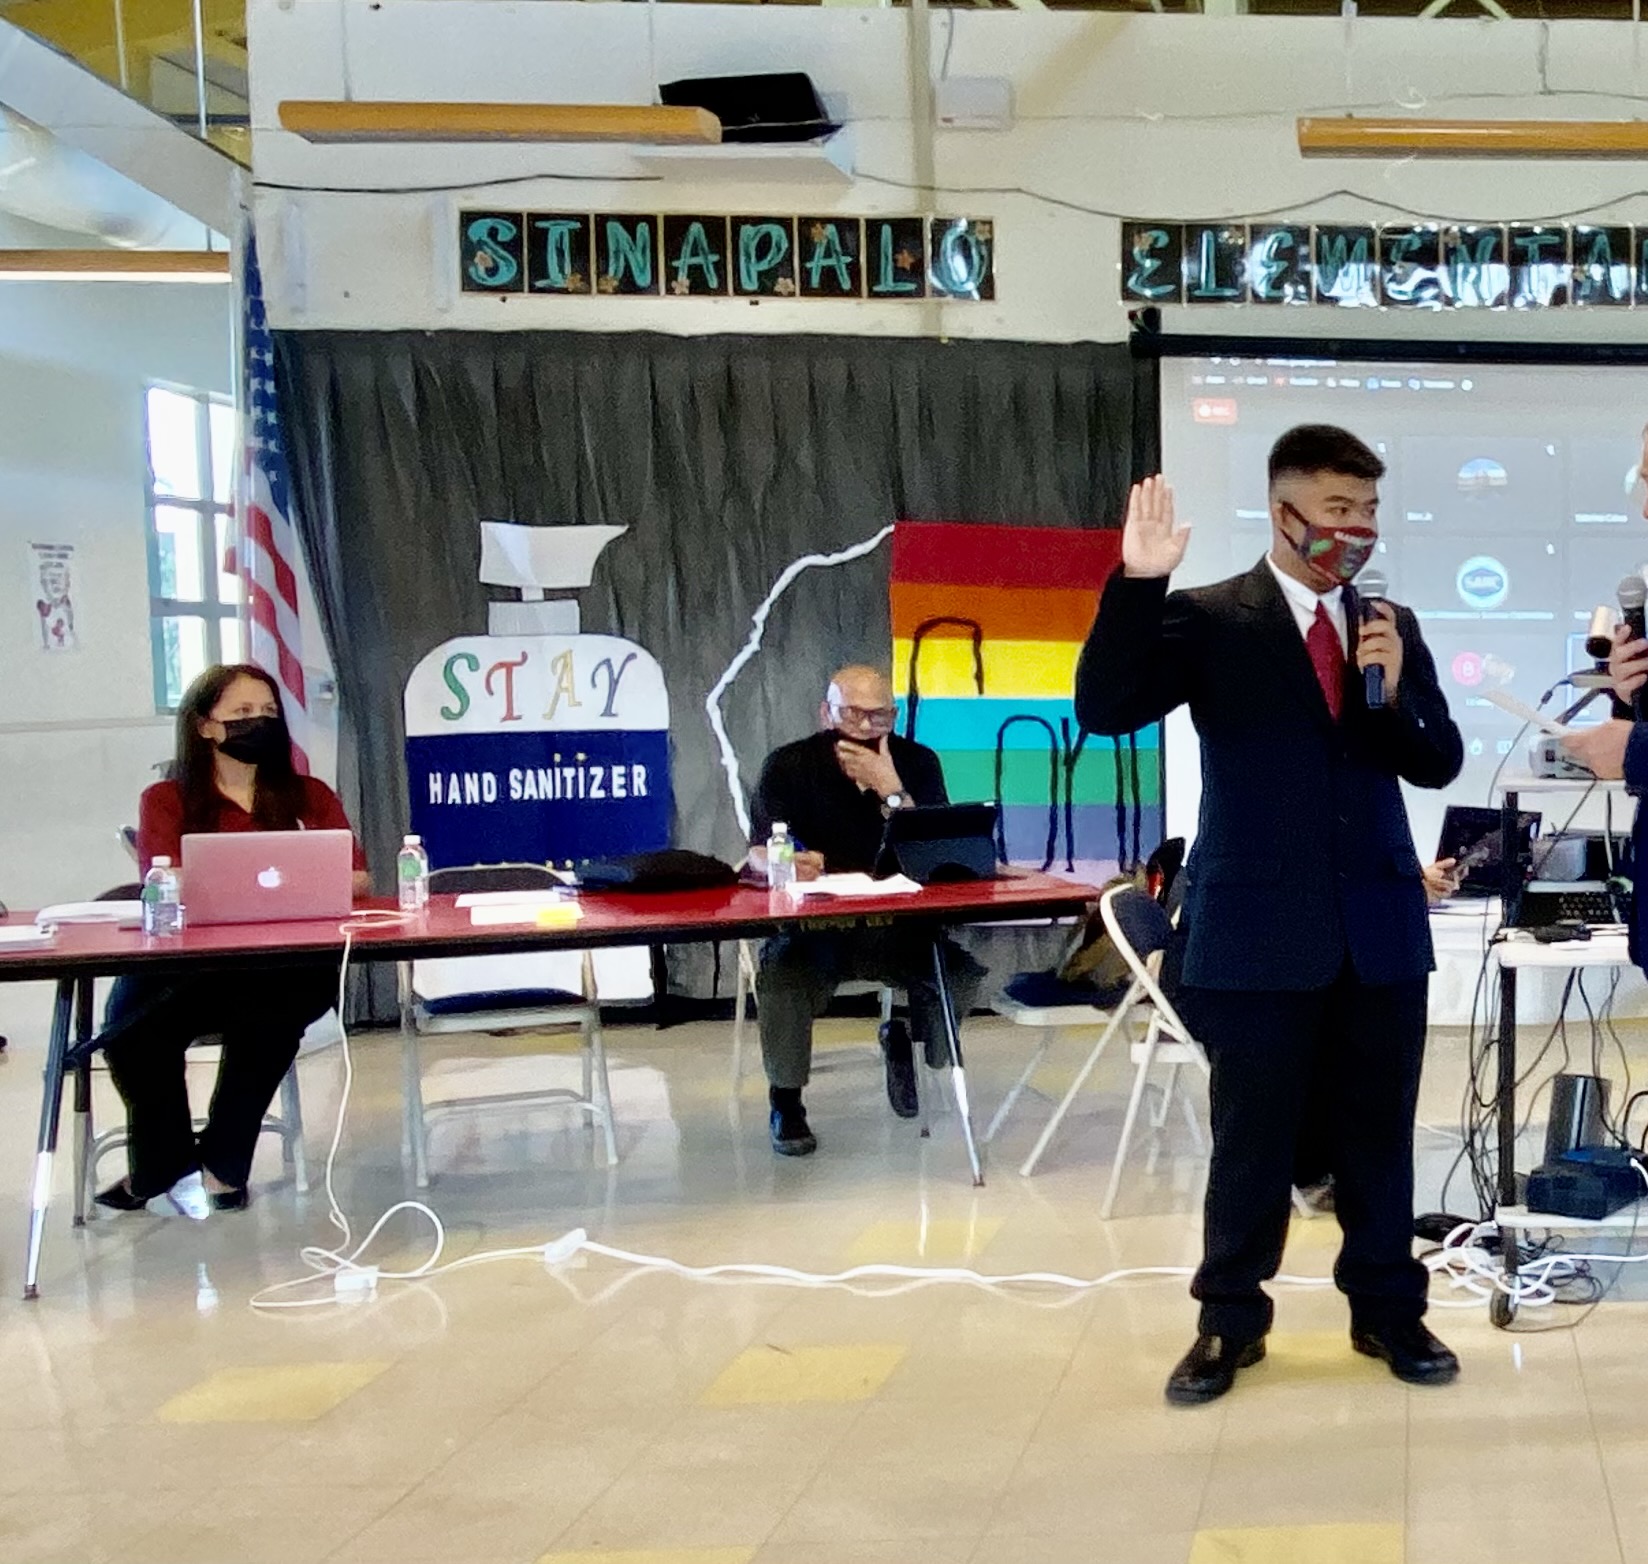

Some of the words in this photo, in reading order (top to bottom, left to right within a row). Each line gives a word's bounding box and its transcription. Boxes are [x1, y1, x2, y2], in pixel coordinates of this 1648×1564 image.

[466, 217, 988, 296] SINAPALO
[440, 648, 638, 723] STAY
[428, 771, 497, 805] HAND
[509, 760, 648, 801] SANITIZER
